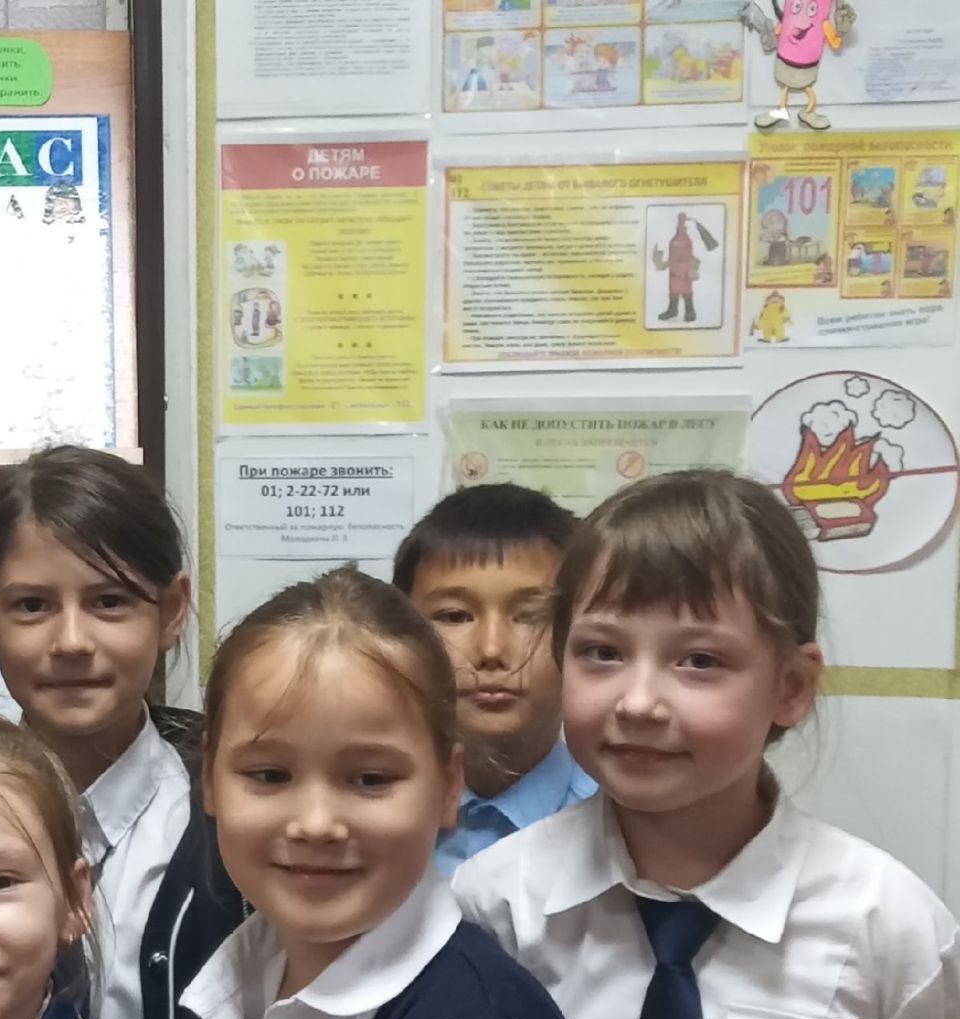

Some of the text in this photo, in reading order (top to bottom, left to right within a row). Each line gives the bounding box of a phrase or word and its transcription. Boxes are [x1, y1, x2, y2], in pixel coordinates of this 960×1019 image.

[306, 148, 365, 165] ДЕТЯМ
[292, 165, 381, 181] О ПОЖАРЕ
[784, 176, 832, 215] 101
[480, 419, 508, 430] КАК
[511, 419, 530, 430] НЕ
[531, 419, 615, 431] ДОПУСТИТЬ
[617, 419, 667, 430] ПОЖАР
[680, 418, 717, 430] ЛЕСУ
[239, 465, 394, 479] При пожаре звонить:
[261, 485, 371, 499] 01; 2-22-72 или
[286, 506, 345, 518] 101; 112
